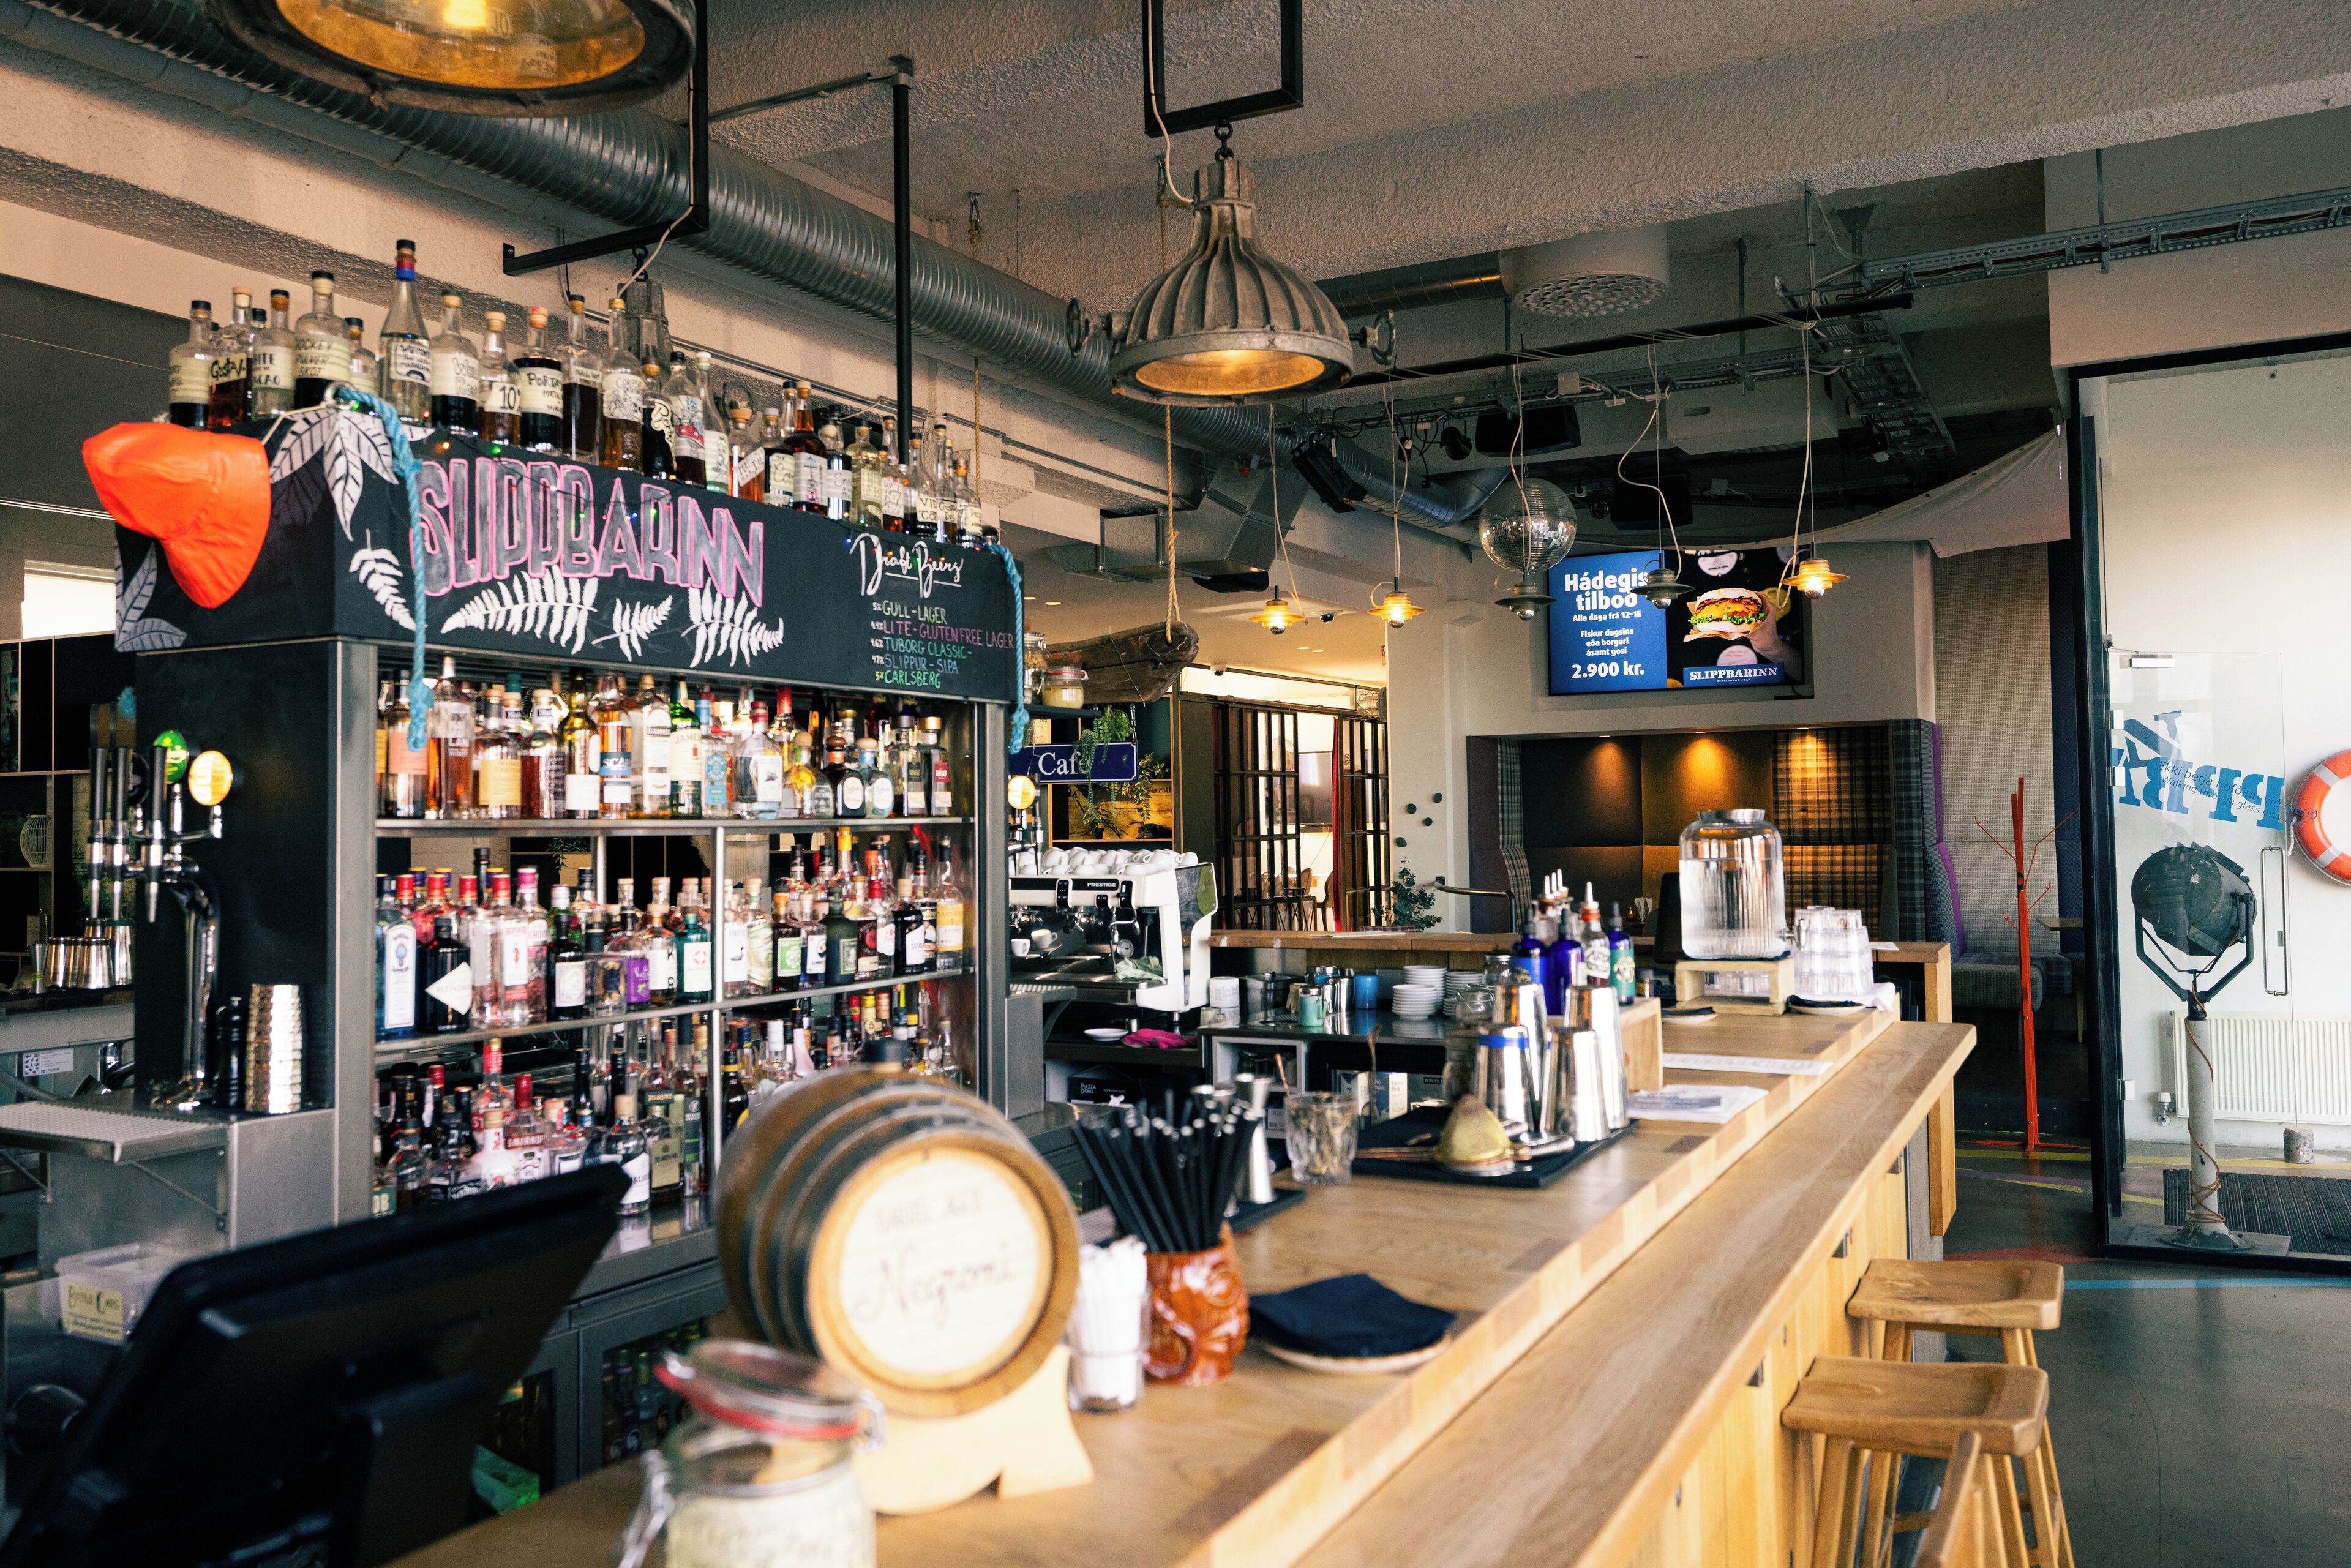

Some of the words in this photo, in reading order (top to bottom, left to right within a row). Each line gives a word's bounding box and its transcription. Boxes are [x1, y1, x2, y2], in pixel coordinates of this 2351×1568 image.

[409, 457, 763, 607] SLIPPBARINN
[849, 532, 912, 597] Draft
[1565, 568, 1649, 595] Hádegis
[1572, 613, 1588, 622] Alla
[1588, 613, 1607, 622] daga
[985, 630, 1014, 649] LAGER
[1580, 629, 1604, 638] Fiskur
[1605, 628, 1634, 637] dagsins
[1601, 637, 1629, 647] borgari
[882, 636, 925, 655] TUBORG
[1586, 648, 1610, 656] ásamt
[1611, 647, 1627, 656] gosi
[884, 653, 928, 672] SLIPPUR
[1571, 662, 1619, 678] 2.900
[1623, 660, 1645, 676] kr.
[884, 669, 941, 689] CARLSBERG
[1690, 667, 1778, 680] SLIPPBARINN
[2158, 760, 2183, 776] Ekki
[2184, 768, 2213, 786] berja
[2162, 775, 2197, 794] Walking
[2199, 787, 2235, 805] through
[2236, 800, 2260, 814] glass
